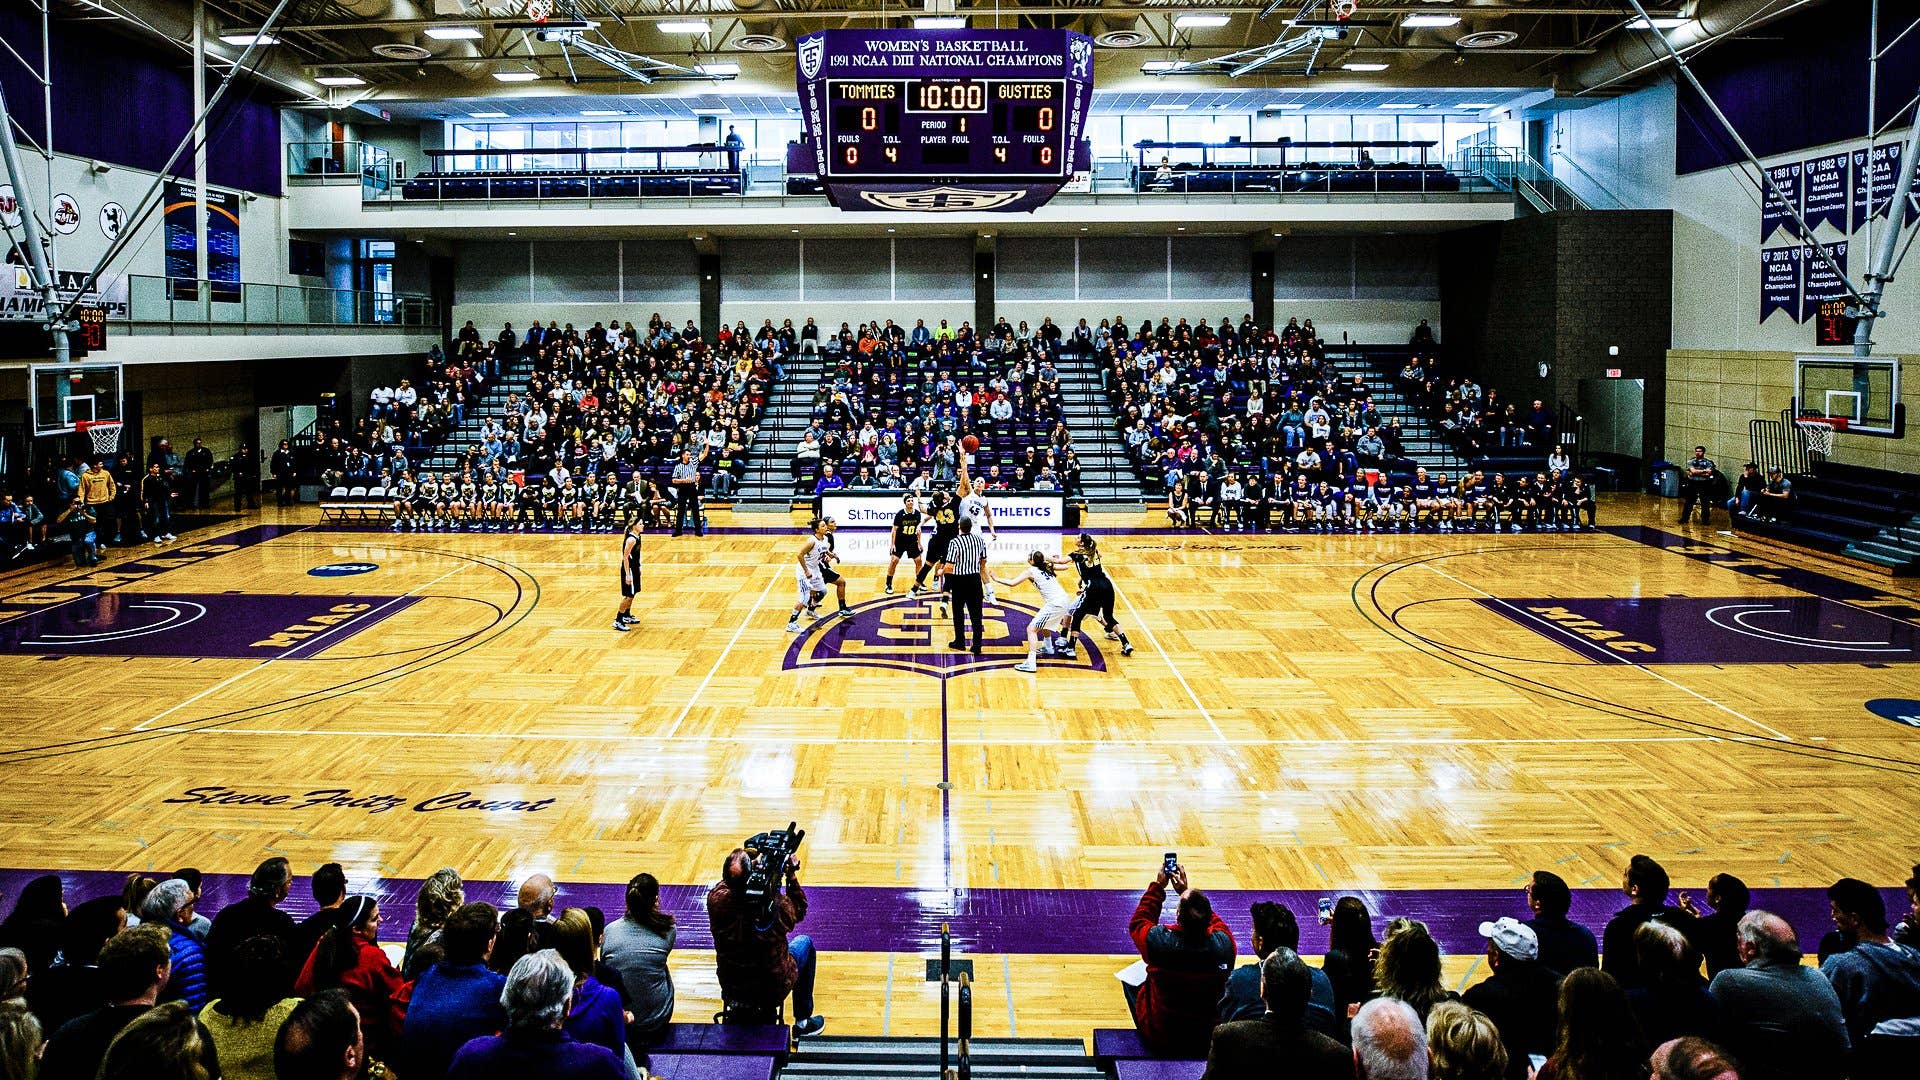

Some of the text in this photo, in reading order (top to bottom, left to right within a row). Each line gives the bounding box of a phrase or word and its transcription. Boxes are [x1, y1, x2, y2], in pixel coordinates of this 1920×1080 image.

[865, 40, 1028, 52] WOMEN'S BASKETBALL
[830, 55, 1063, 67] 1991 NCAA DIII NATIONAL CHAMPIONS
[840, 84, 895, 99] TOMMIES
[920, 85, 981, 109] 10:00
[998, 84, 1052, 99] GUSTIES
[862, 107, 876, 131] 0
[921, 117, 966, 133] PERIOD 1
[1039, 107, 1053, 131] 0
[837, 135, 860, 143] FOULS
[882, 135, 901, 144] T.O.L.
[920, 135, 970, 144] PLAYER FOUL
[992, 135, 1011, 144] T.O.L.
[1023, 135, 1045, 144] FOULS
[846, 146, 858, 164] 0
[885, 147, 897, 163] 4
[994, 147, 1006, 163] 4
[1041, 146, 1052, 164] 0
[1817, 159, 1836, 171] 1982
[1773, 168, 1790, 179] 1981
[1813, 172, 1839, 184] NCAA
[1812, 182, 1839, 192] National
[1807, 191, 1844, 202] Champions
[1772, 251, 1789, 261] 2012
[1769, 263, 1792, 272] NCAA
[1807, 280, 1842, 288] Champions
[1821, 301, 1846, 316] 10:00
[80, 308, 104, 323] 10:00
[984, 507, 1051, 517] THLETICS
[249, 603, 371, 648] MIAC
[1526, 606, 1656, 653] MIAC
[162, 786, 557, 814] Steve Fritz Court
